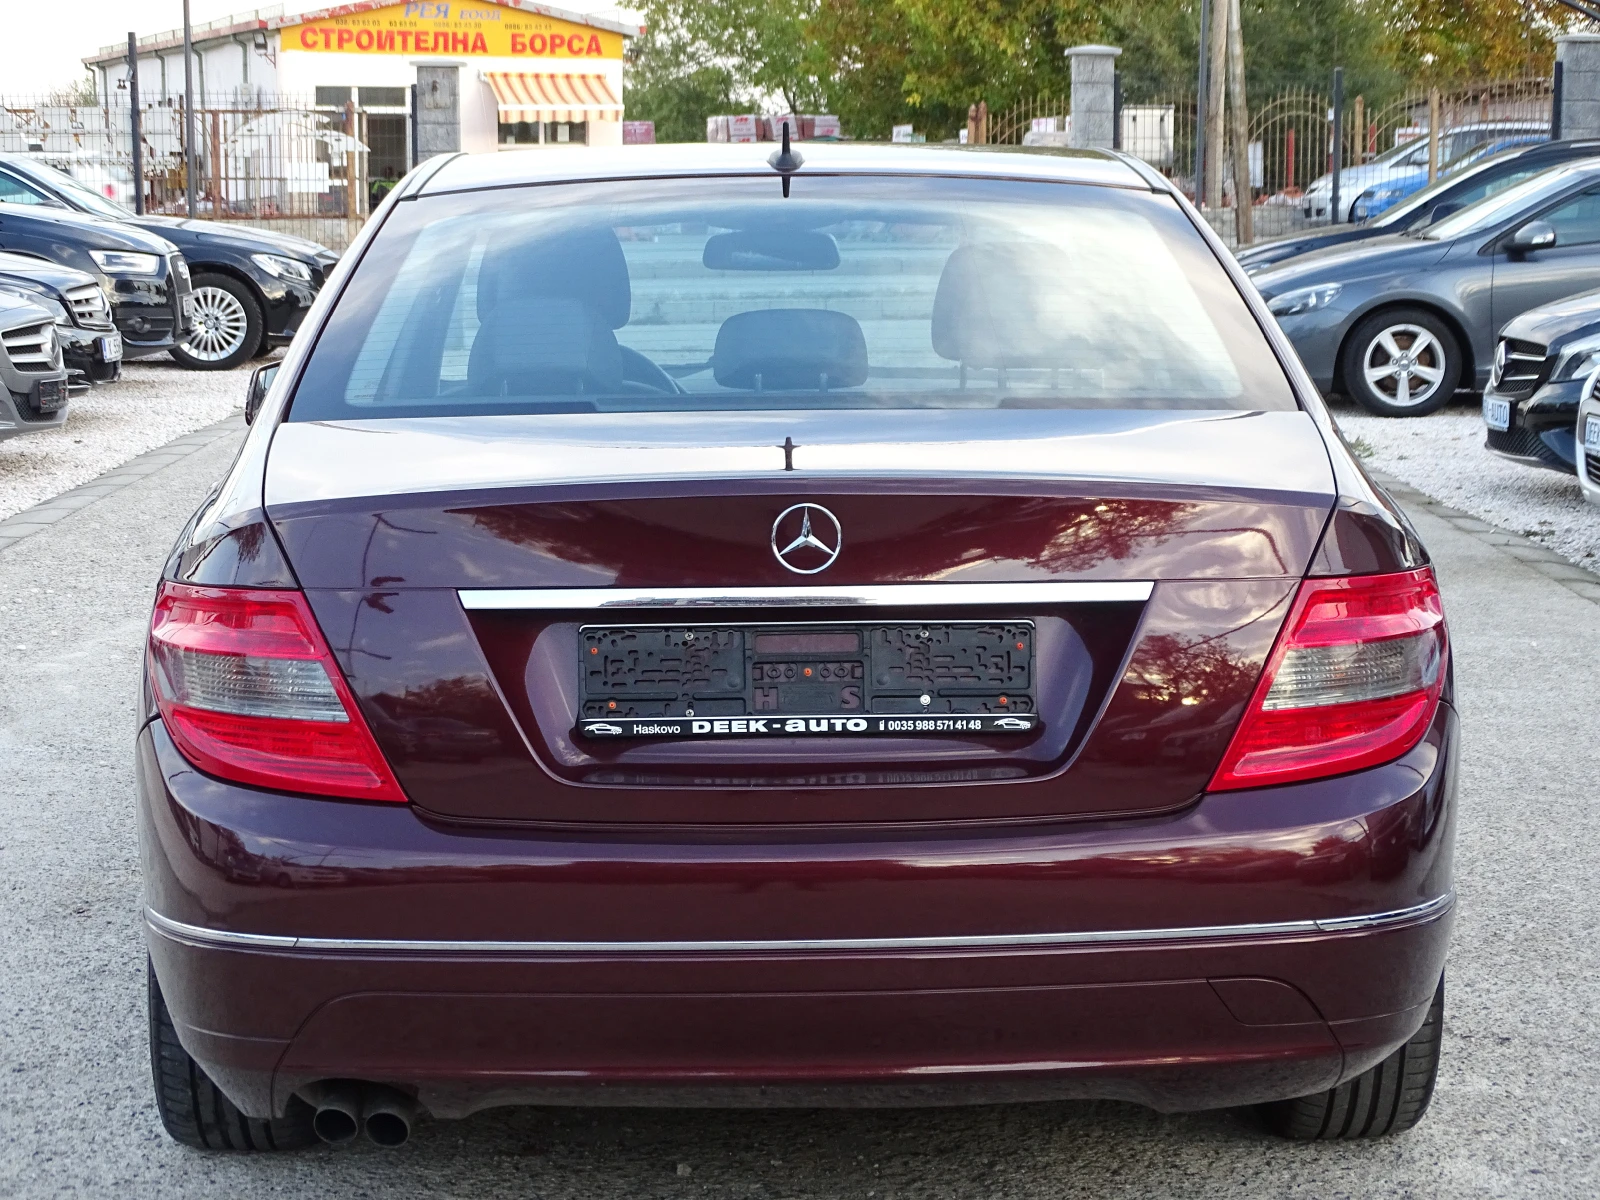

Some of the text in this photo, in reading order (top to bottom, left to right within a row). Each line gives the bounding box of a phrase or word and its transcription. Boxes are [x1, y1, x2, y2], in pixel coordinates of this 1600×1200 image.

[404, 2, 450, 18] РЕЯ
[300, 26, 603, 56] СТРОИТЕЛНА БОРСА
[633, 723, 681, 734] Haskovo
[888, 720, 914, 731] 0035
[915, 720, 935, 731] 988
[936, 720, 954, 730] 571
